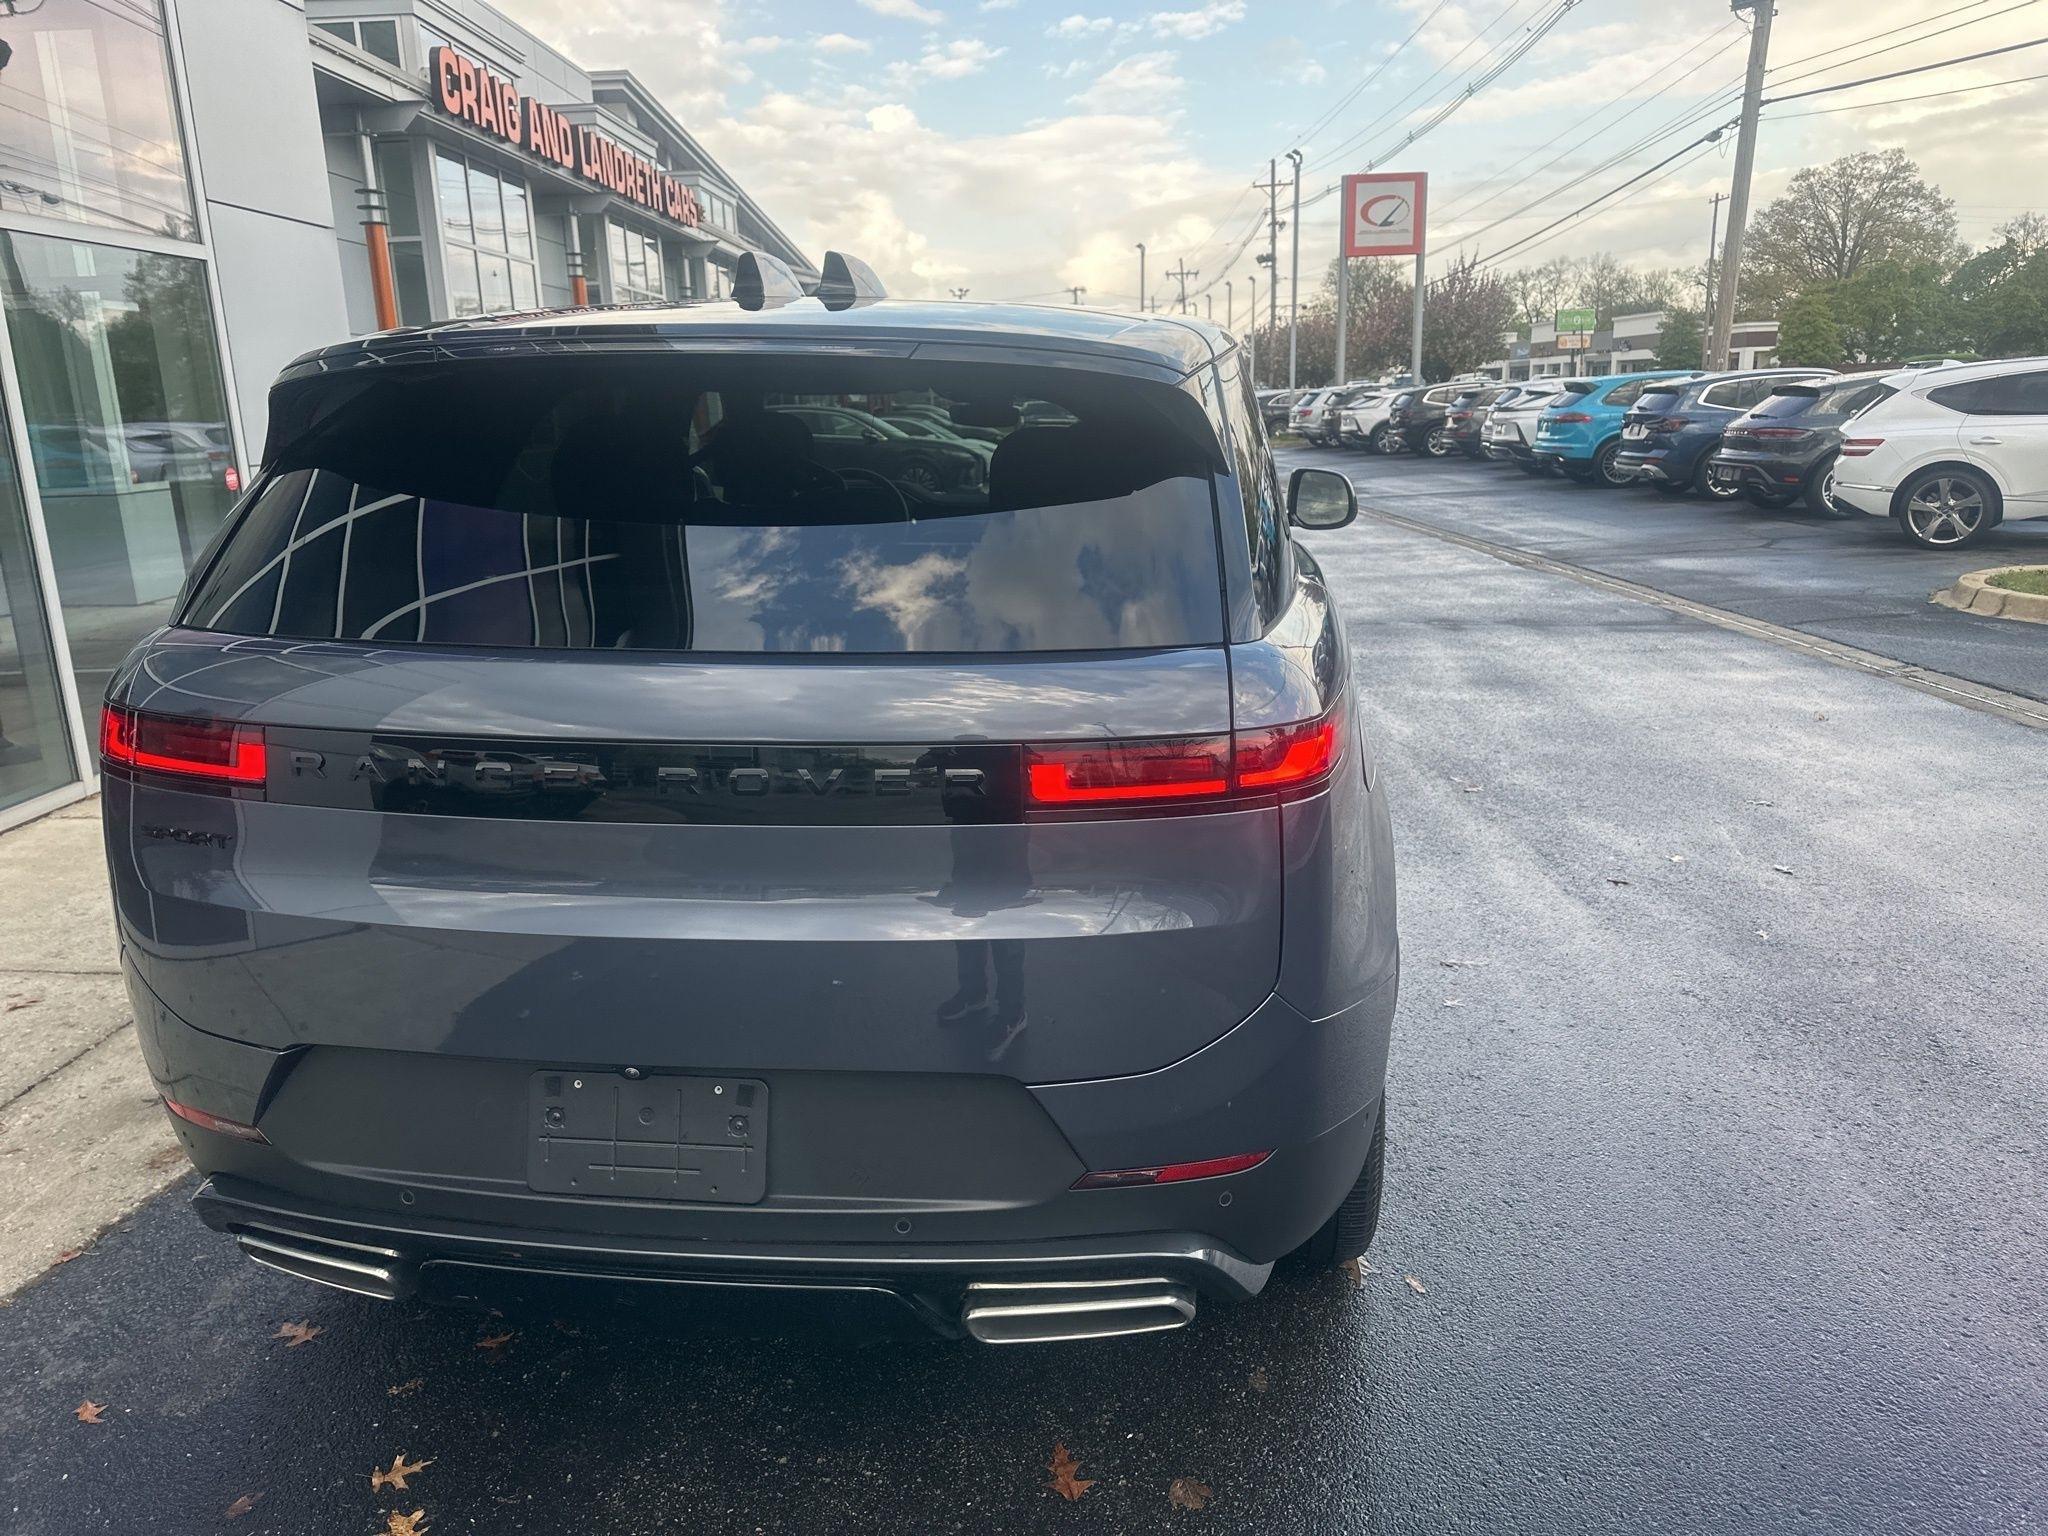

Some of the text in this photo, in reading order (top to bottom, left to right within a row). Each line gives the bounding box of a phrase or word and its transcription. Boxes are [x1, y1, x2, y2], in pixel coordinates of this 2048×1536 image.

[435, 46, 699, 228] CRAIG AND LANDRETH CARS
[290, 751, 987, 796] RANGE ROVER
